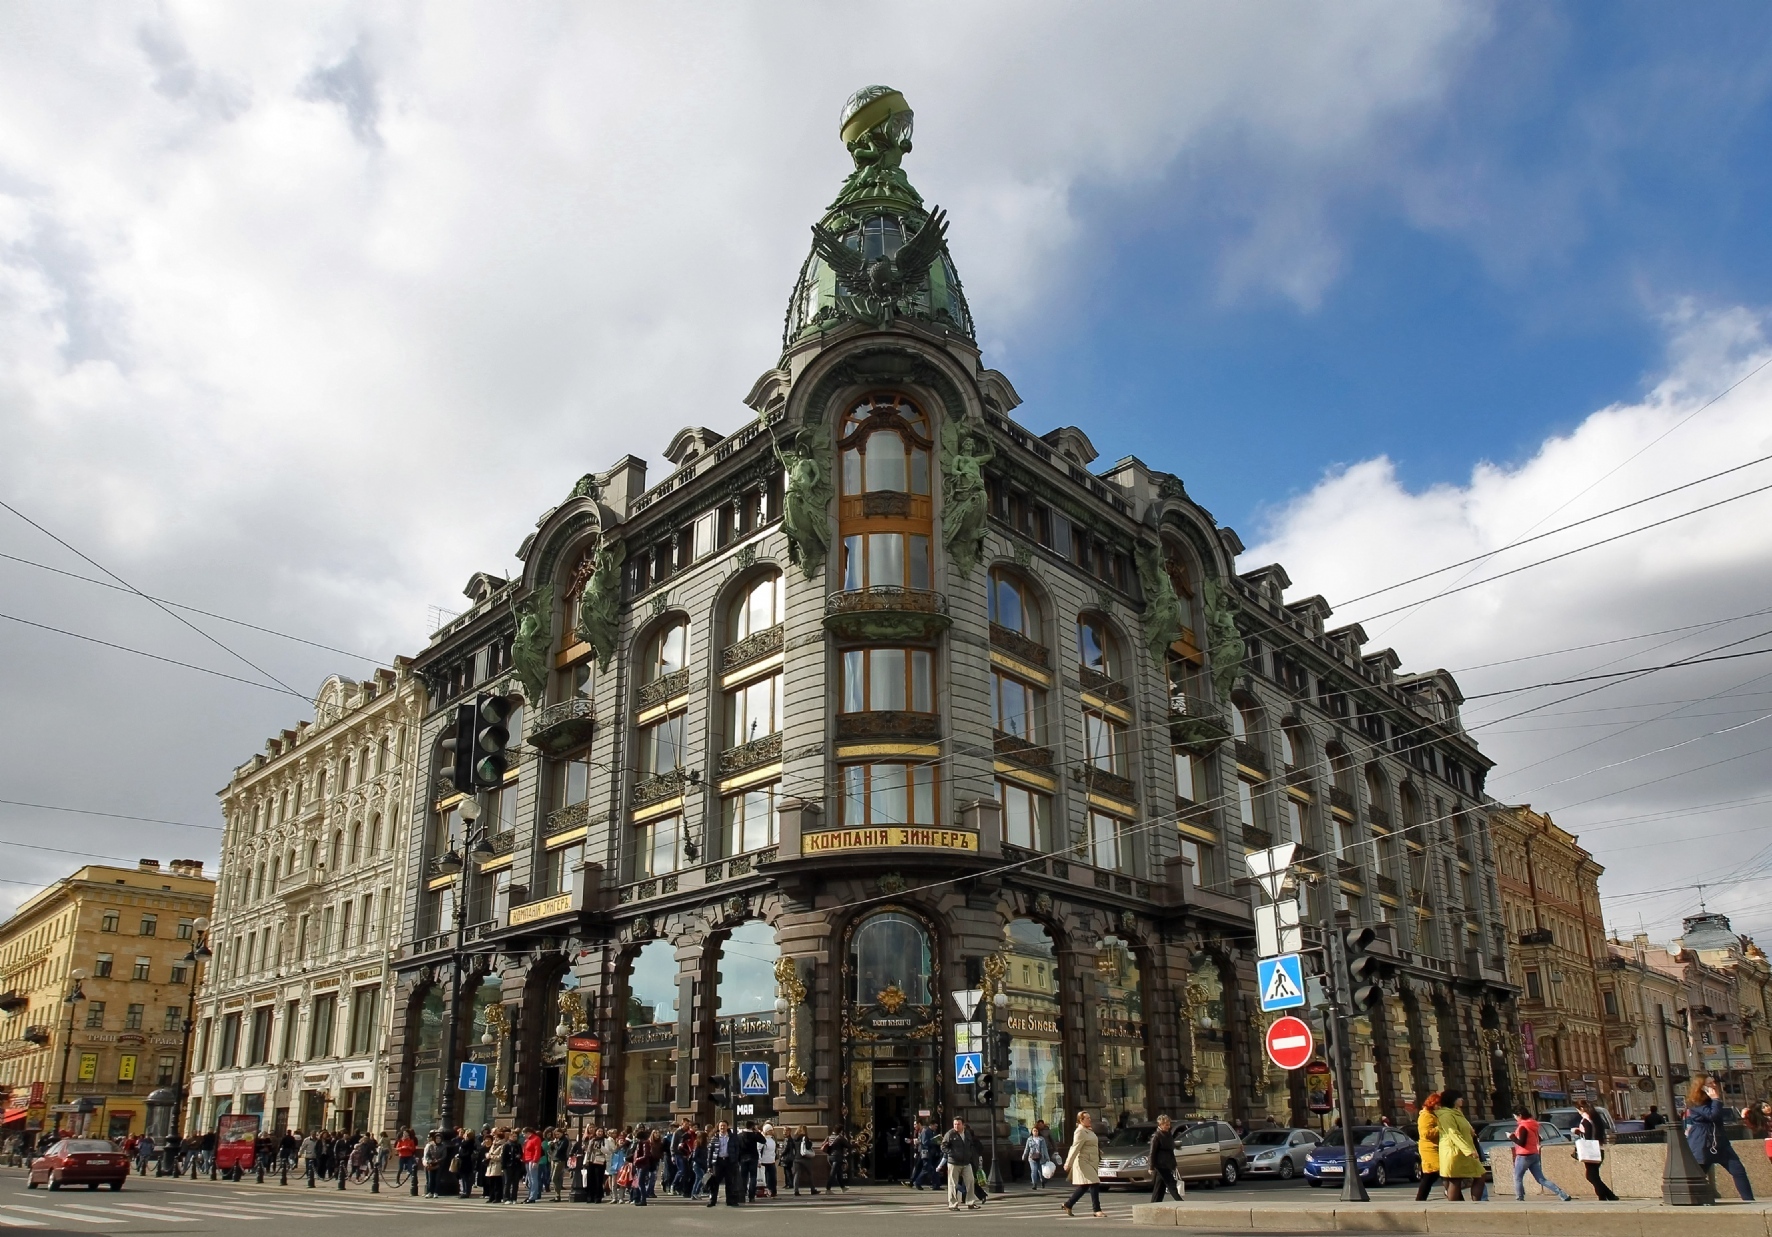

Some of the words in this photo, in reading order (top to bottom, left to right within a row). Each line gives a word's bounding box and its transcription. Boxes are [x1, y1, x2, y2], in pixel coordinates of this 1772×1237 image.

[900, 829, 969, 849] ЗИНГЕРЪ
[719, 1023, 738, 1037] CAE
[1007, 1016, 1026, 1030] CAFE
[1028, 1014, 1059, 1033] SINGER
[736, 1104, 754, 1116] МАЯ
